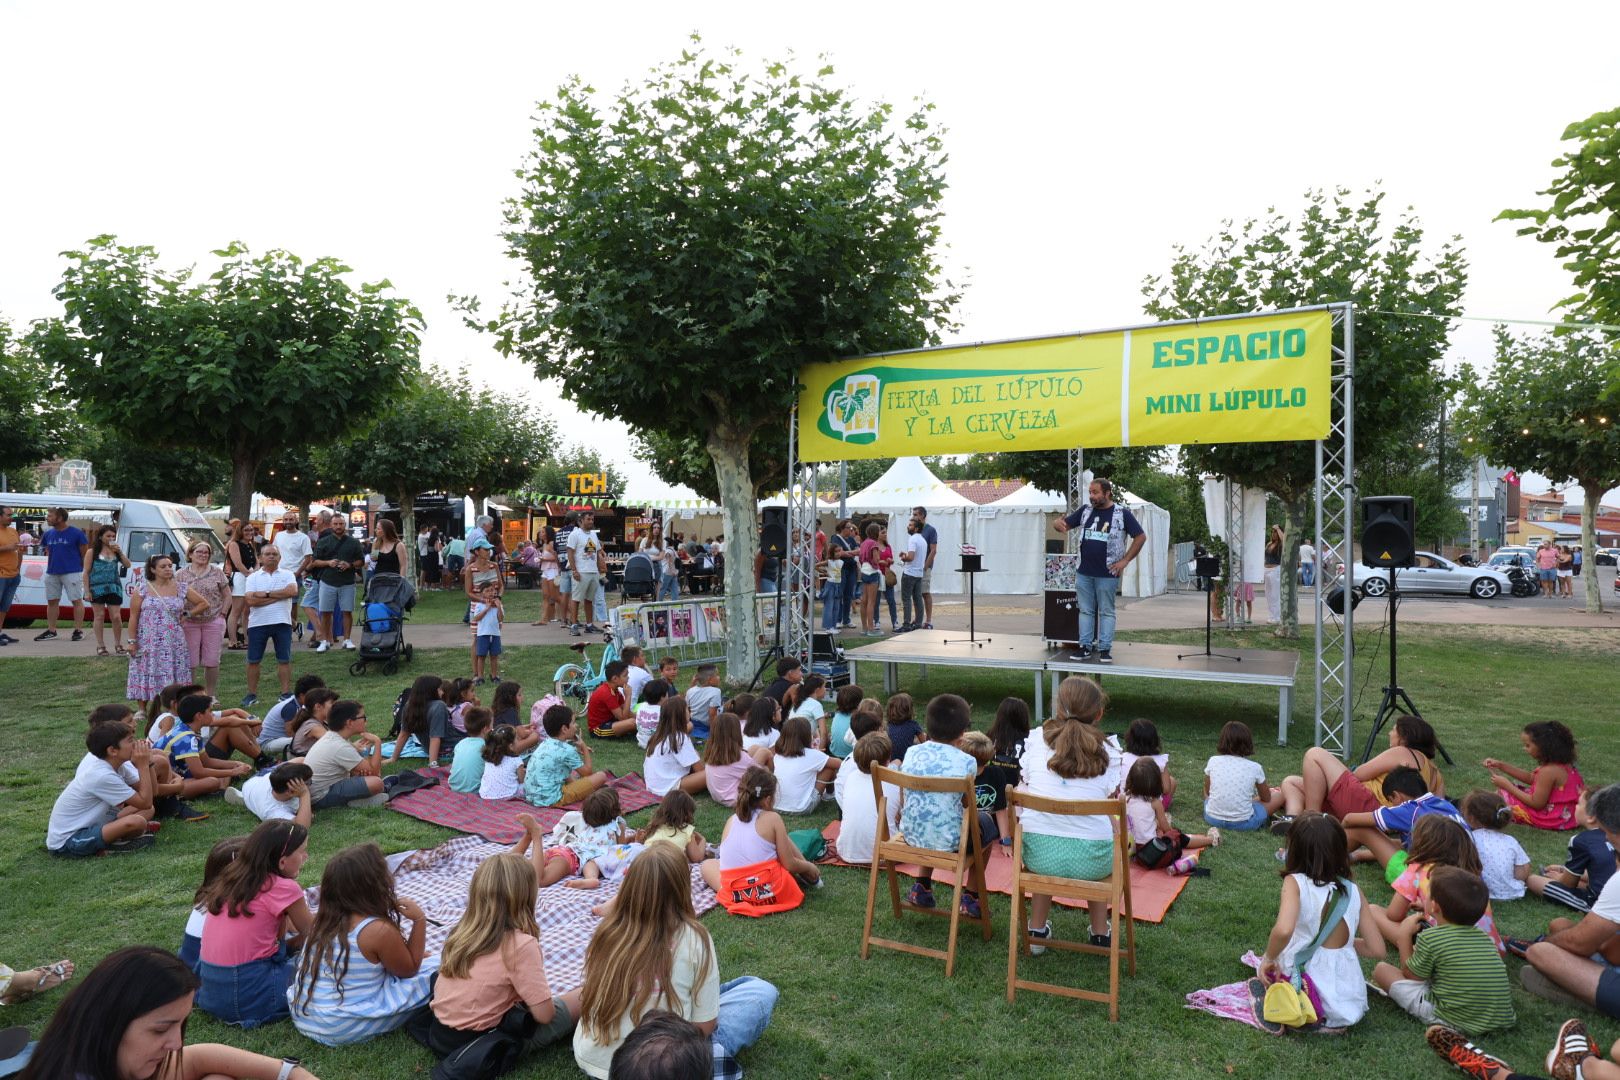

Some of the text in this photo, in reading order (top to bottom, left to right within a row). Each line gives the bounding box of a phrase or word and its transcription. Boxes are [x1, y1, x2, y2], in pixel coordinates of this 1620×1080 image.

[1151, 327, 1306, 369] ESPACIO
[887, 376, 1083, 416] FERIA DEL LÚPULO
[1145, 387, 1307, 415] MINI LÚPULO
[904, 409, 1059, 441] Y LA CERVEZA
[567, 471, 608, 494] TCH
